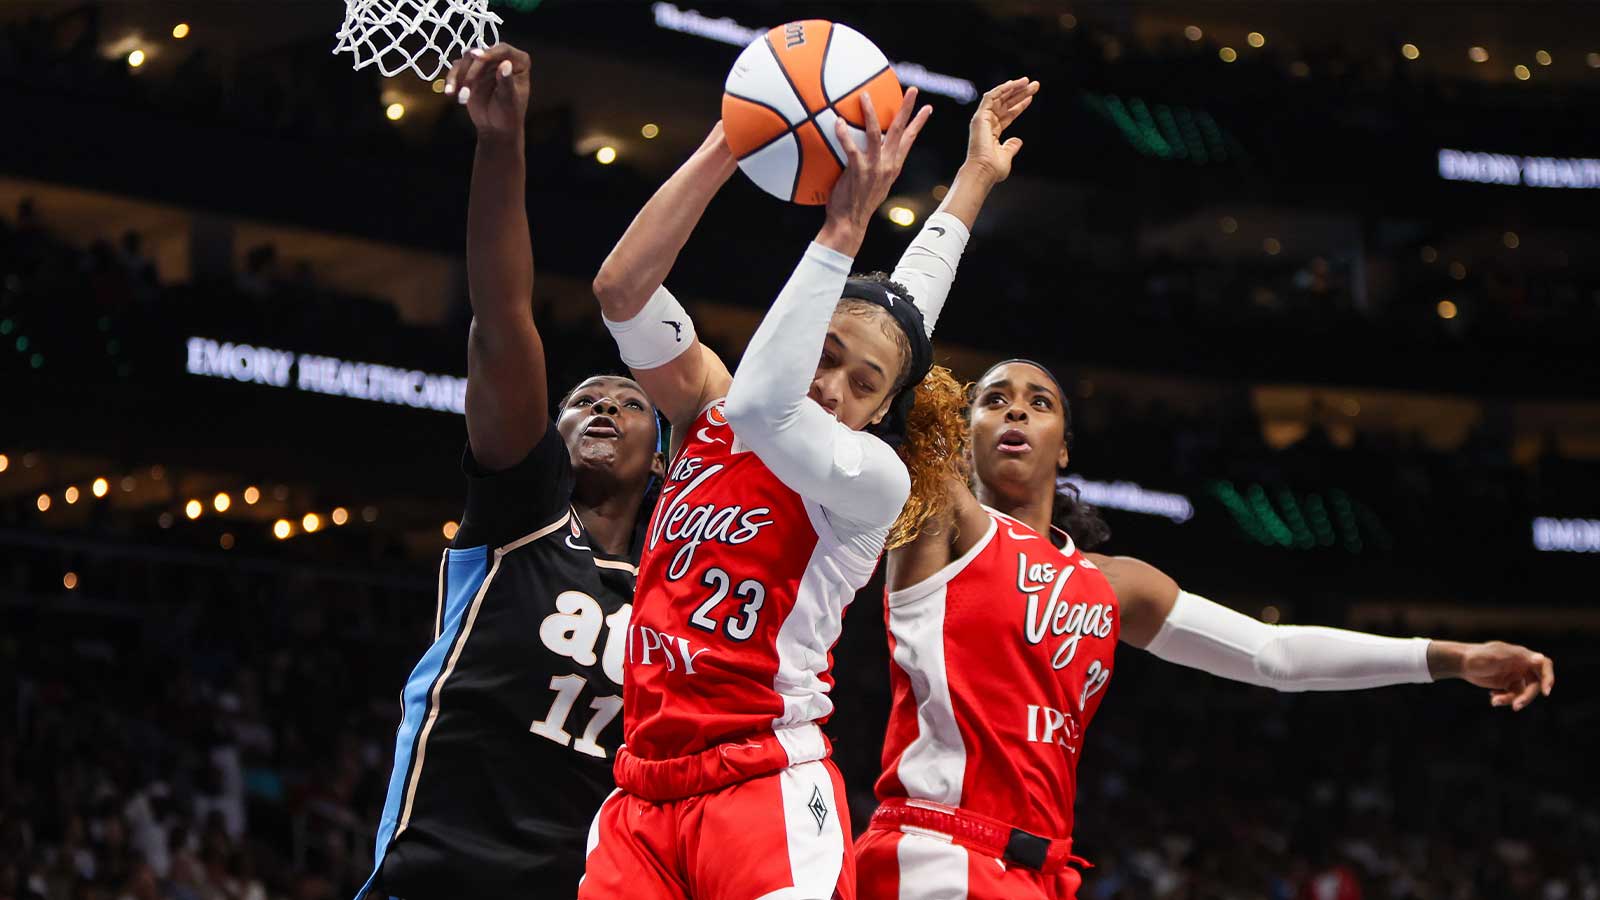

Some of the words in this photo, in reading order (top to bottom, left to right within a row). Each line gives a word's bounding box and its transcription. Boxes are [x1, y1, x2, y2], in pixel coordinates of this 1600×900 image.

[187, 336, 295, 388] EMORY
[648, 464, 774, 581] Vegas
[689, 567, 766, 643] 23
[1017, 552, 1058, 593] Las
[628, 624, 711, 675] IPSY
[1025, 565, 1114, 671] Vegas
[529, 673, 625, 759] 11
